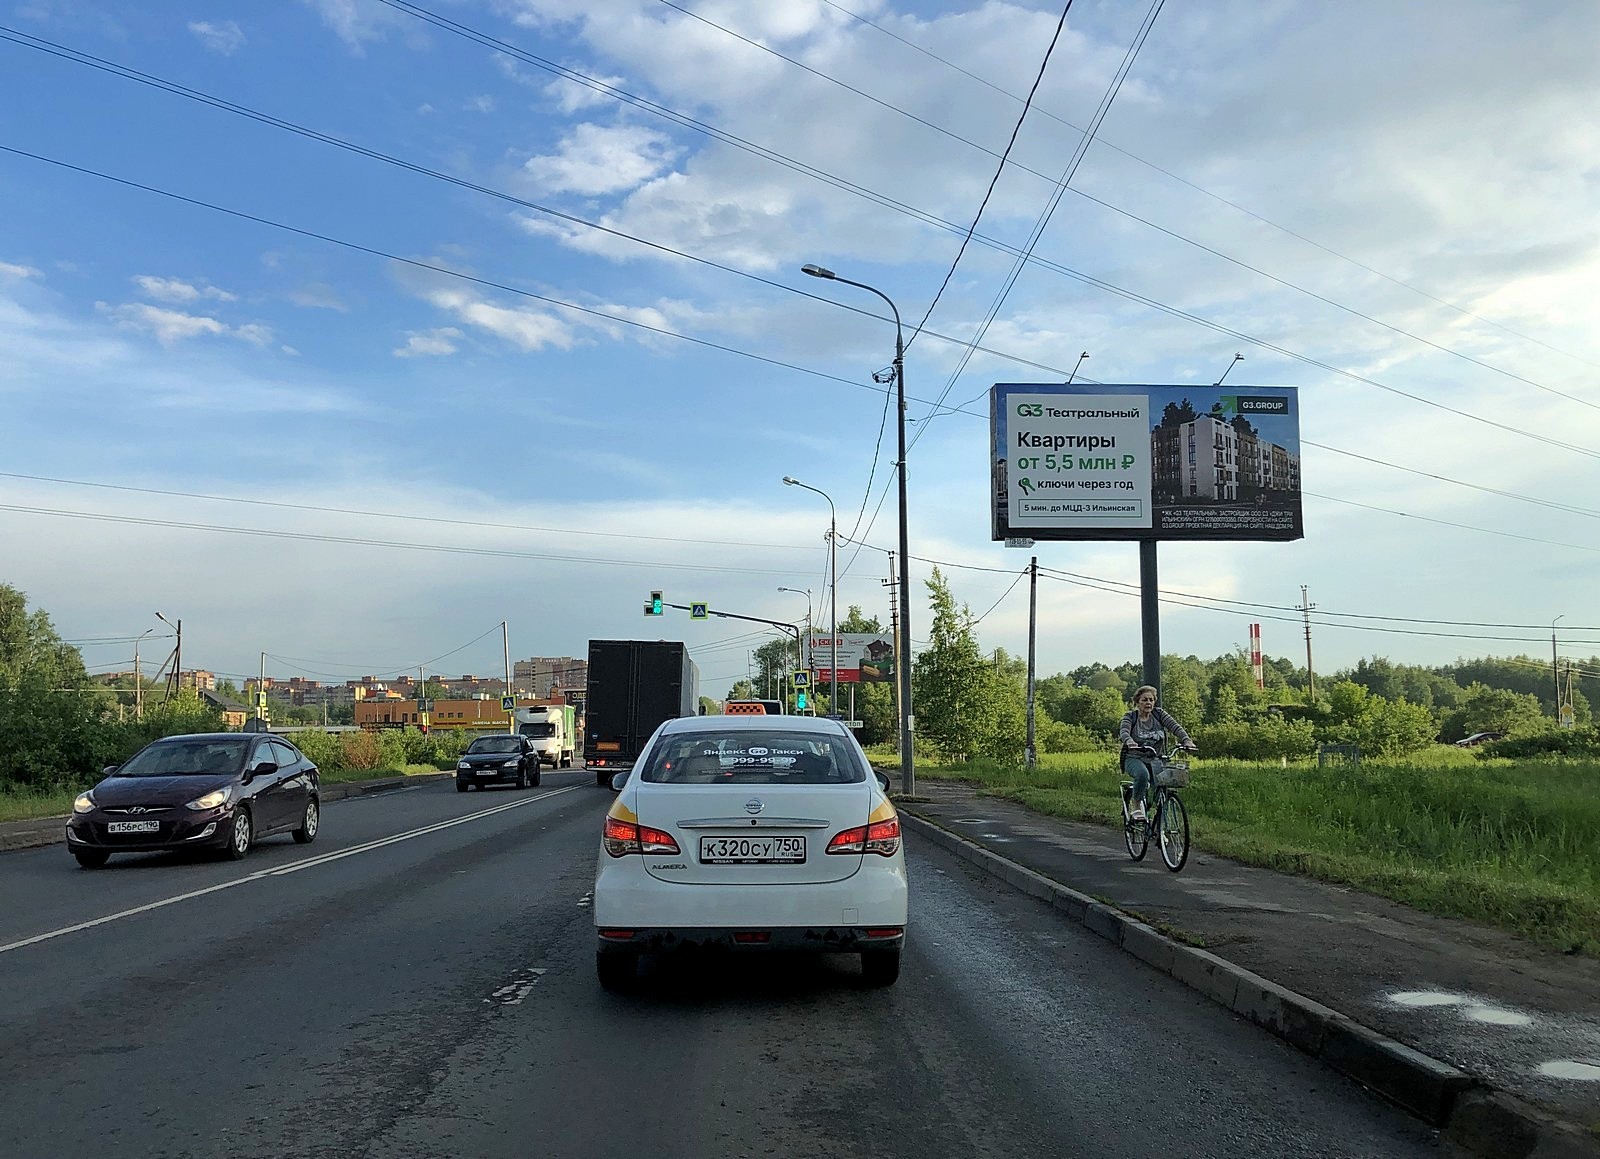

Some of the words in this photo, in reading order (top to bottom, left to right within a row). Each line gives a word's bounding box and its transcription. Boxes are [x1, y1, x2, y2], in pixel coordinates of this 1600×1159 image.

[1242, 401, 1283, 410] G3.GROUP
[1017, 403, 1043, 417] G3
[1045, 408, 1140, 419] Театральный
[1017, 431, 1116, 451] Квартиры
[1017, 457, 1039, 470] от
[1045, 454, 1074, 473] 5,5
[1079, 457, 1116, 470] млн
[1121, 454, 1135, 470] ₽
[1037, 480, 1075, 489] ключи
[1078, 480, 1111, 490] через
[1114, 480, 1134, 490] год
[1024, 504, 1029, 512] 5
[1050, 505, 1061, 513] до
[1062, 504, 1091, 513] МЦД-3
[1092, 504, 1136, 512] Ильинская
[703, 748, 746, 756] Яндекс
[110, 822, 143, 832] В156РС
[706, 839, 772, 857] К320СУ
[775, 838, 800, 852] 750
